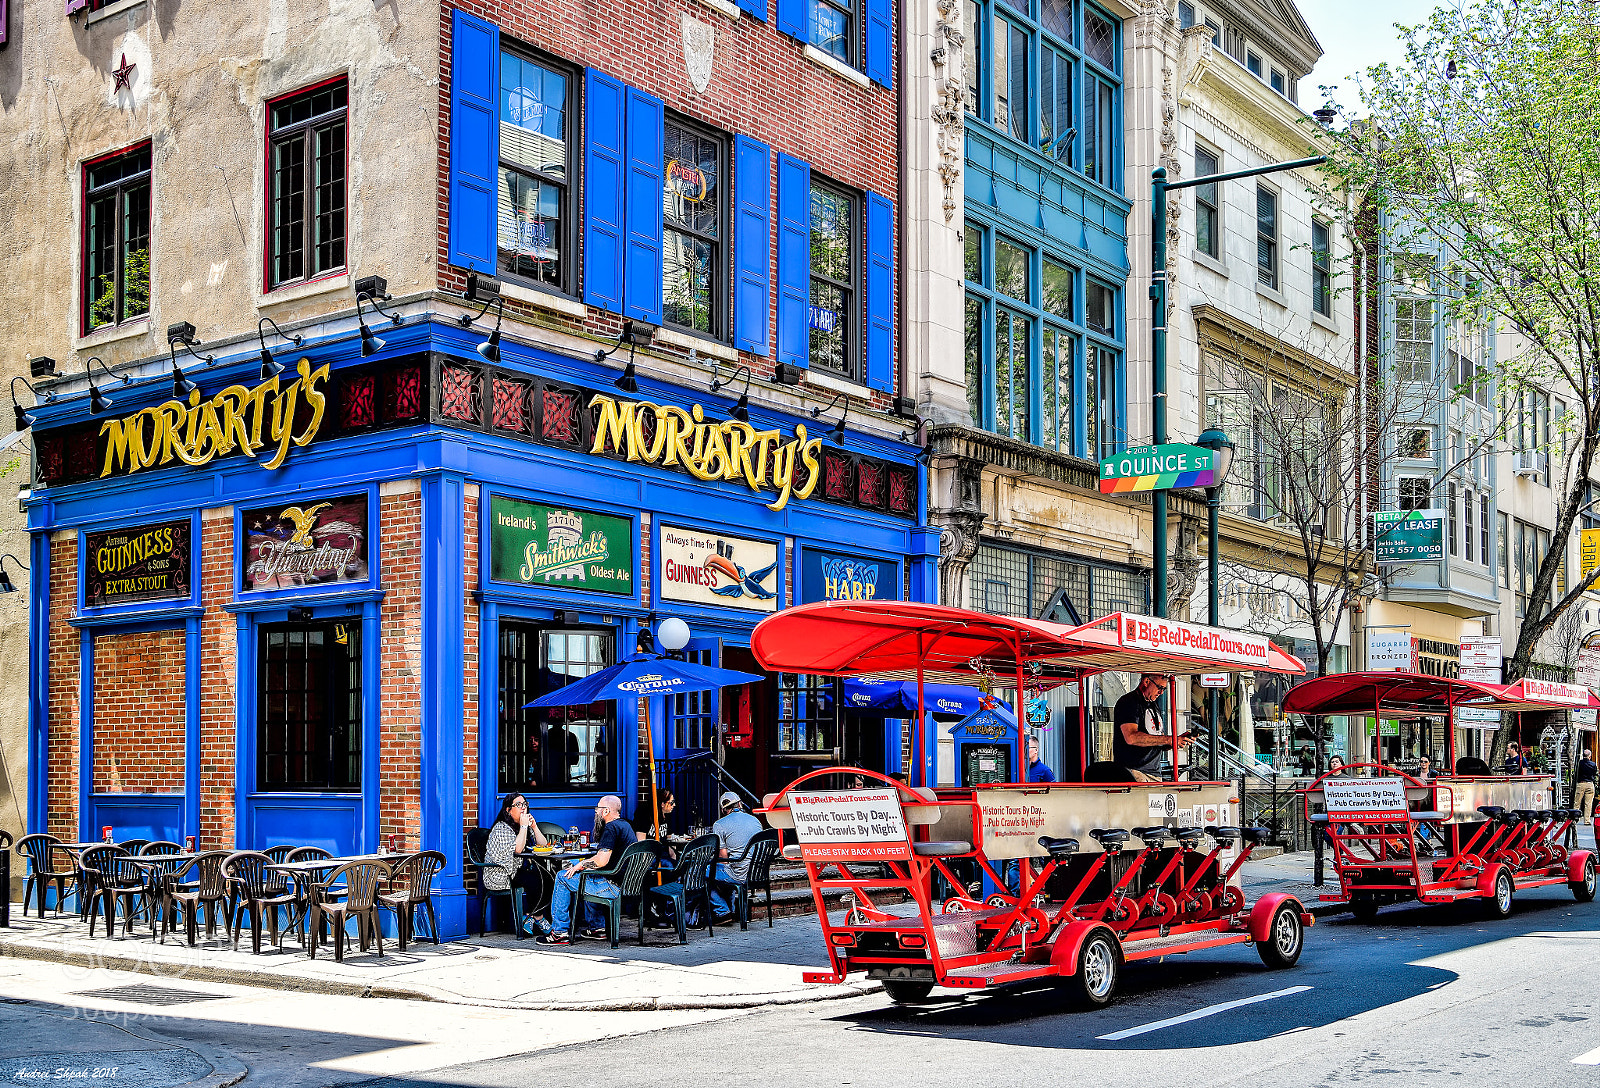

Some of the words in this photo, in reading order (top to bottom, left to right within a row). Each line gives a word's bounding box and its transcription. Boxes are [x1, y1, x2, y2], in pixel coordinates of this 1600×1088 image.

[1133, 447, 1148, 455] 200
[1151, 445, 1158, 455] S
[1120, 453, 1188, 477] QUINCE
[1194, 456, 1209, 469] ST
[498, 512, 537, 531] Ireland's
[554, 516, 575, 526] 1710
[1377, 512, 1409, 521] RETA
[1377, 521, 1400, 532] FOR
[1404, 520, 1438, 531] LEASE
[666, 532, 690, 548] Always
[690, 536, 705, 549] time
[706, 539, 716, 550] for
[97, 527, 173, 573] GUINNESS
[689, 552, 694, 560] a
[1377, 546, 1395, 555] 215
[1397, 546, 1415, 554] 557
[1417, 545, 1441, 553] 0050
[255, 535, 357, 584] Yuengling
[519, 531, 607, 582] Smithwick's
[590, 565, 615, 580] Oldest
[616, 569, 630, 581] Ale
[665, 558, 718, 587] GUINNESS
[105, 579, 137, 595] EXTRA
[137, 575, 168, 591] STOUT
[825, 577, 876, 601] HARP
[1138, 622, 1267, 658] BigRedPedalTours.com
[617, 677, 685, 692] Corona
[937, 698, 963, 709] Corona
[802, 795, 889, 805] BigRedPedalTours.com
[1372, 790, 1380, 798] By
[1348, 799, 1370, 807] Crawls
[1382, 799, 1401, 807] Night
[796, 812, 829, 822] Historic
[830, 812, 855, 822] Tours
[856, 811, 868, 822] By
[871, 810, 898, 821] Day...
[982, 806, 1004, 815] Historic
[1006, 806, 1021, 815] Tours
[1022, 806, 1030, 816] By
[1030, 806, 1047, 816] Day...
[983, 818, 1000, 827] ...Pub
[1000, 818, 1020, 827] Crawls
[1021, 818, 1028, 828] By
[1029, 817, 1045, 828] Night
[800, 826, 825, 836] ...Pub
[827, 825, 856, 836] Crawls
[857, 825, 869, 836] By
[871, 823, 898, 836] Night
[833, 848, 851, 856] STAY
[887, 847, 905, 855] FEET
